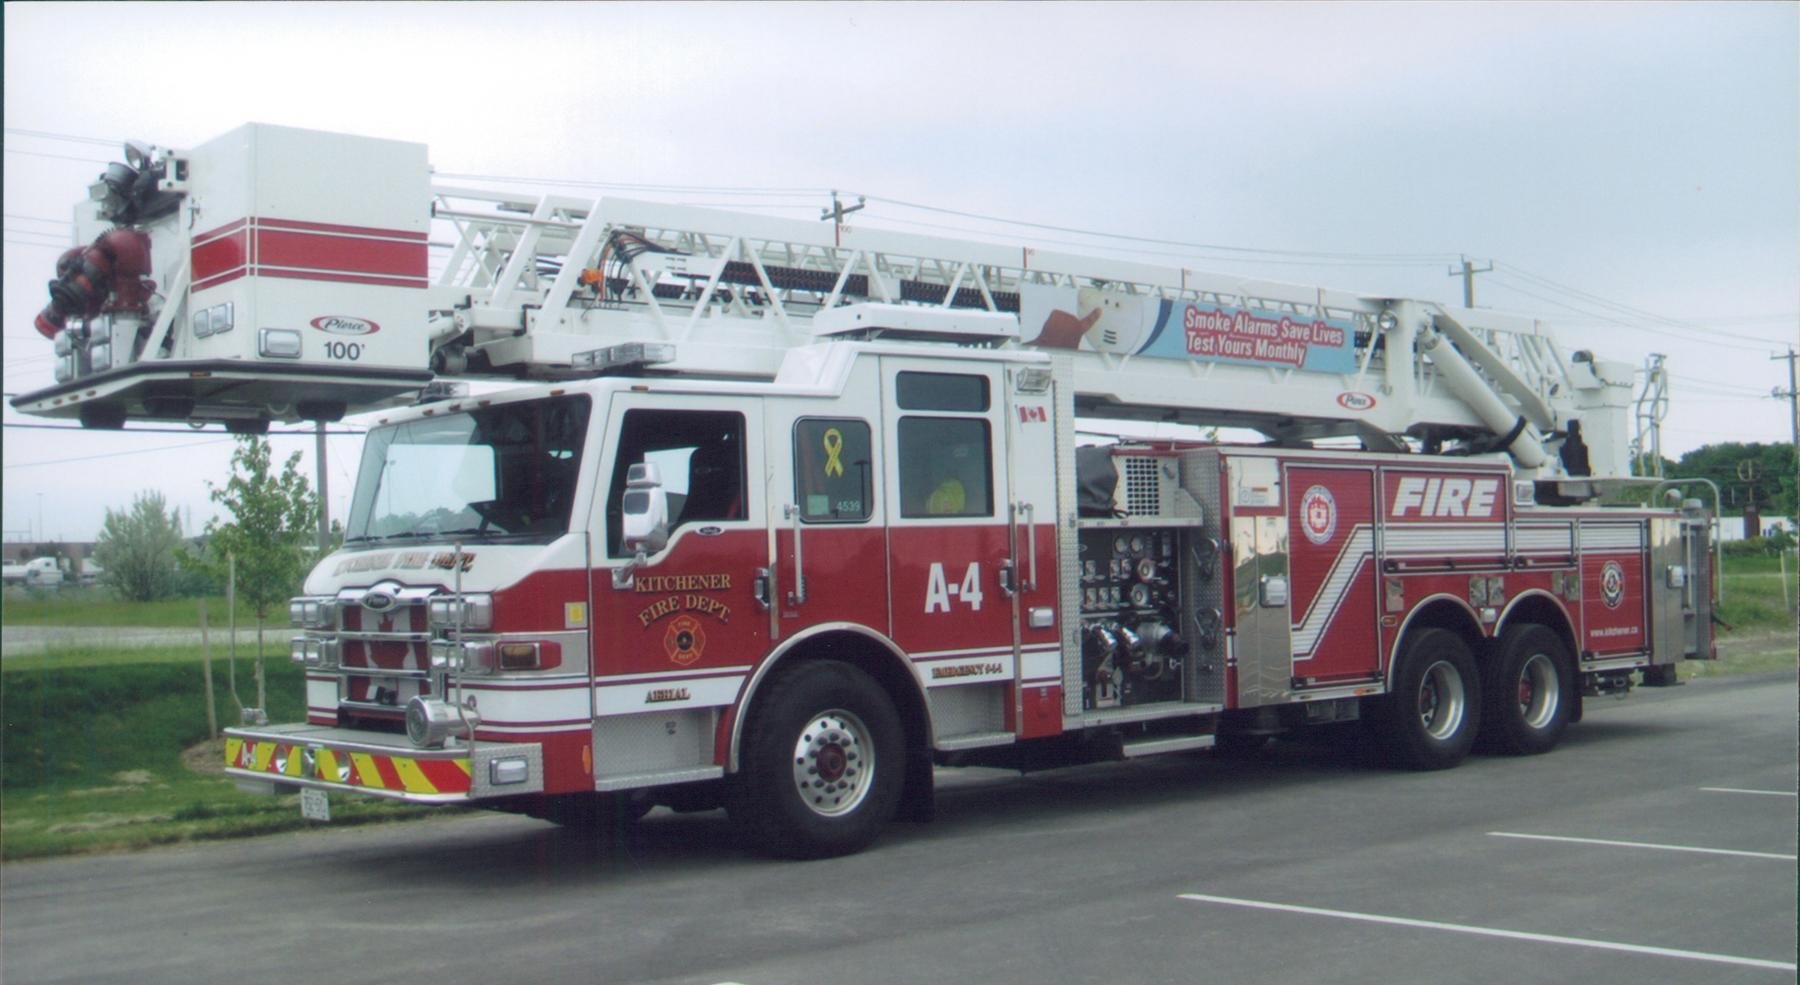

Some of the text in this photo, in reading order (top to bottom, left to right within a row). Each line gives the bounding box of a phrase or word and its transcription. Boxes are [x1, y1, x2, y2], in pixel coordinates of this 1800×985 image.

[324, 318, 365, 331] Pierce
[1186, 308, 1343, 345] Smoke Alarms Save Lives
[1187, 331, 1306, 365] Test Yours Monthly
[836, 500, 861, 512] 4539
[1392, 477, 1499, 517] FIRE
[635, 574, 731, 593] KITCHENER
[924, 561, 984, 614] A-4
[638, 594, 731, 627] FIRE DEPT.
